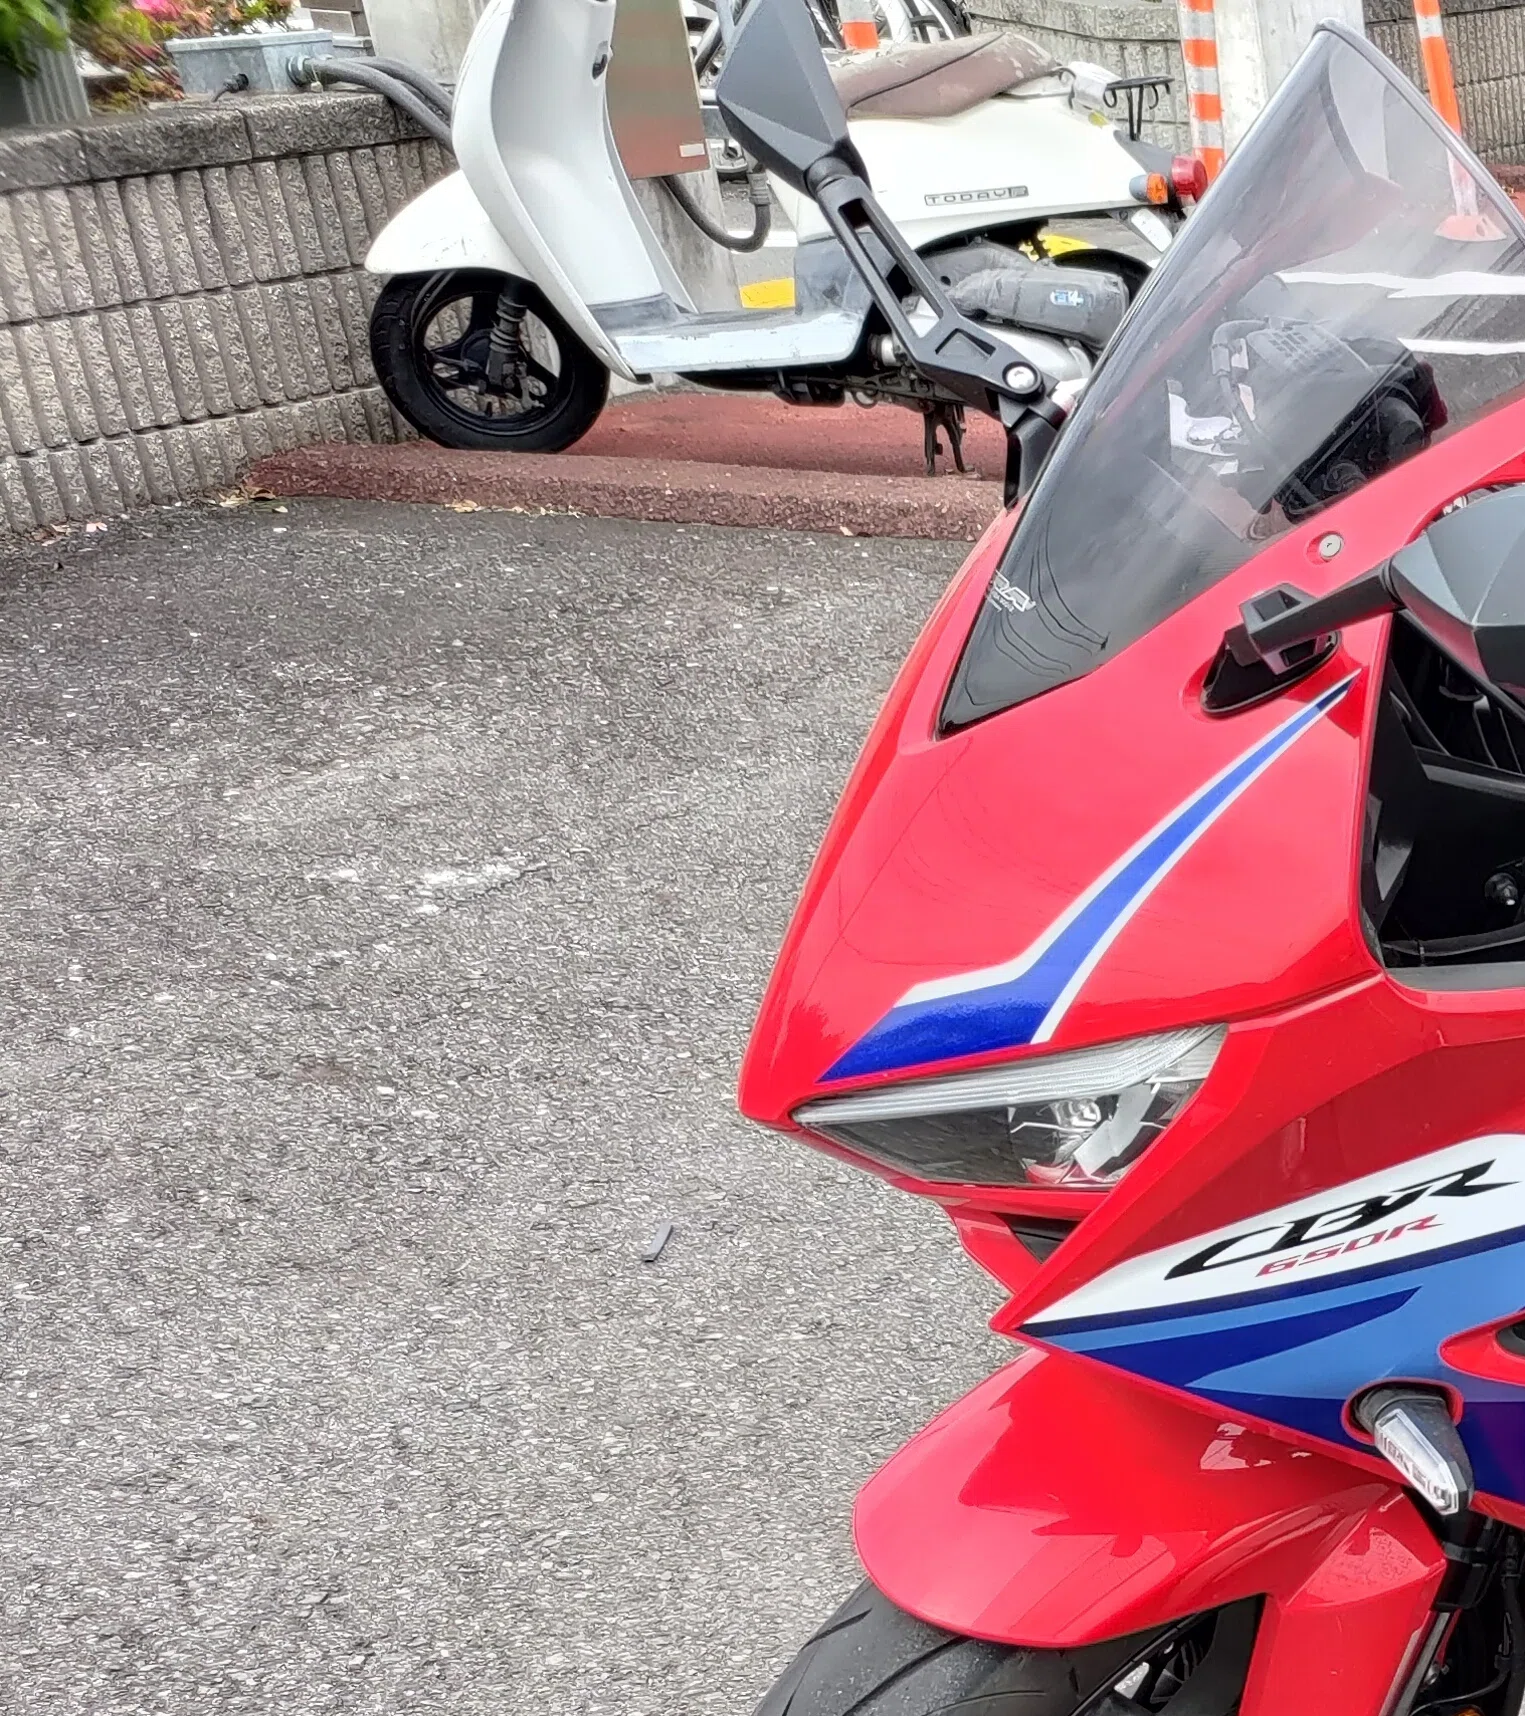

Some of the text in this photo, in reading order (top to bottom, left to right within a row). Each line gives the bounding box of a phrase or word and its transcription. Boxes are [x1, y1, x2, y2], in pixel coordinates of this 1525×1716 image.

[927, 188, 1007, 204] TODAY
[1164, 1159, 1523, 1281] CBR
[1255, 1214, 1447, 1278] 650R
